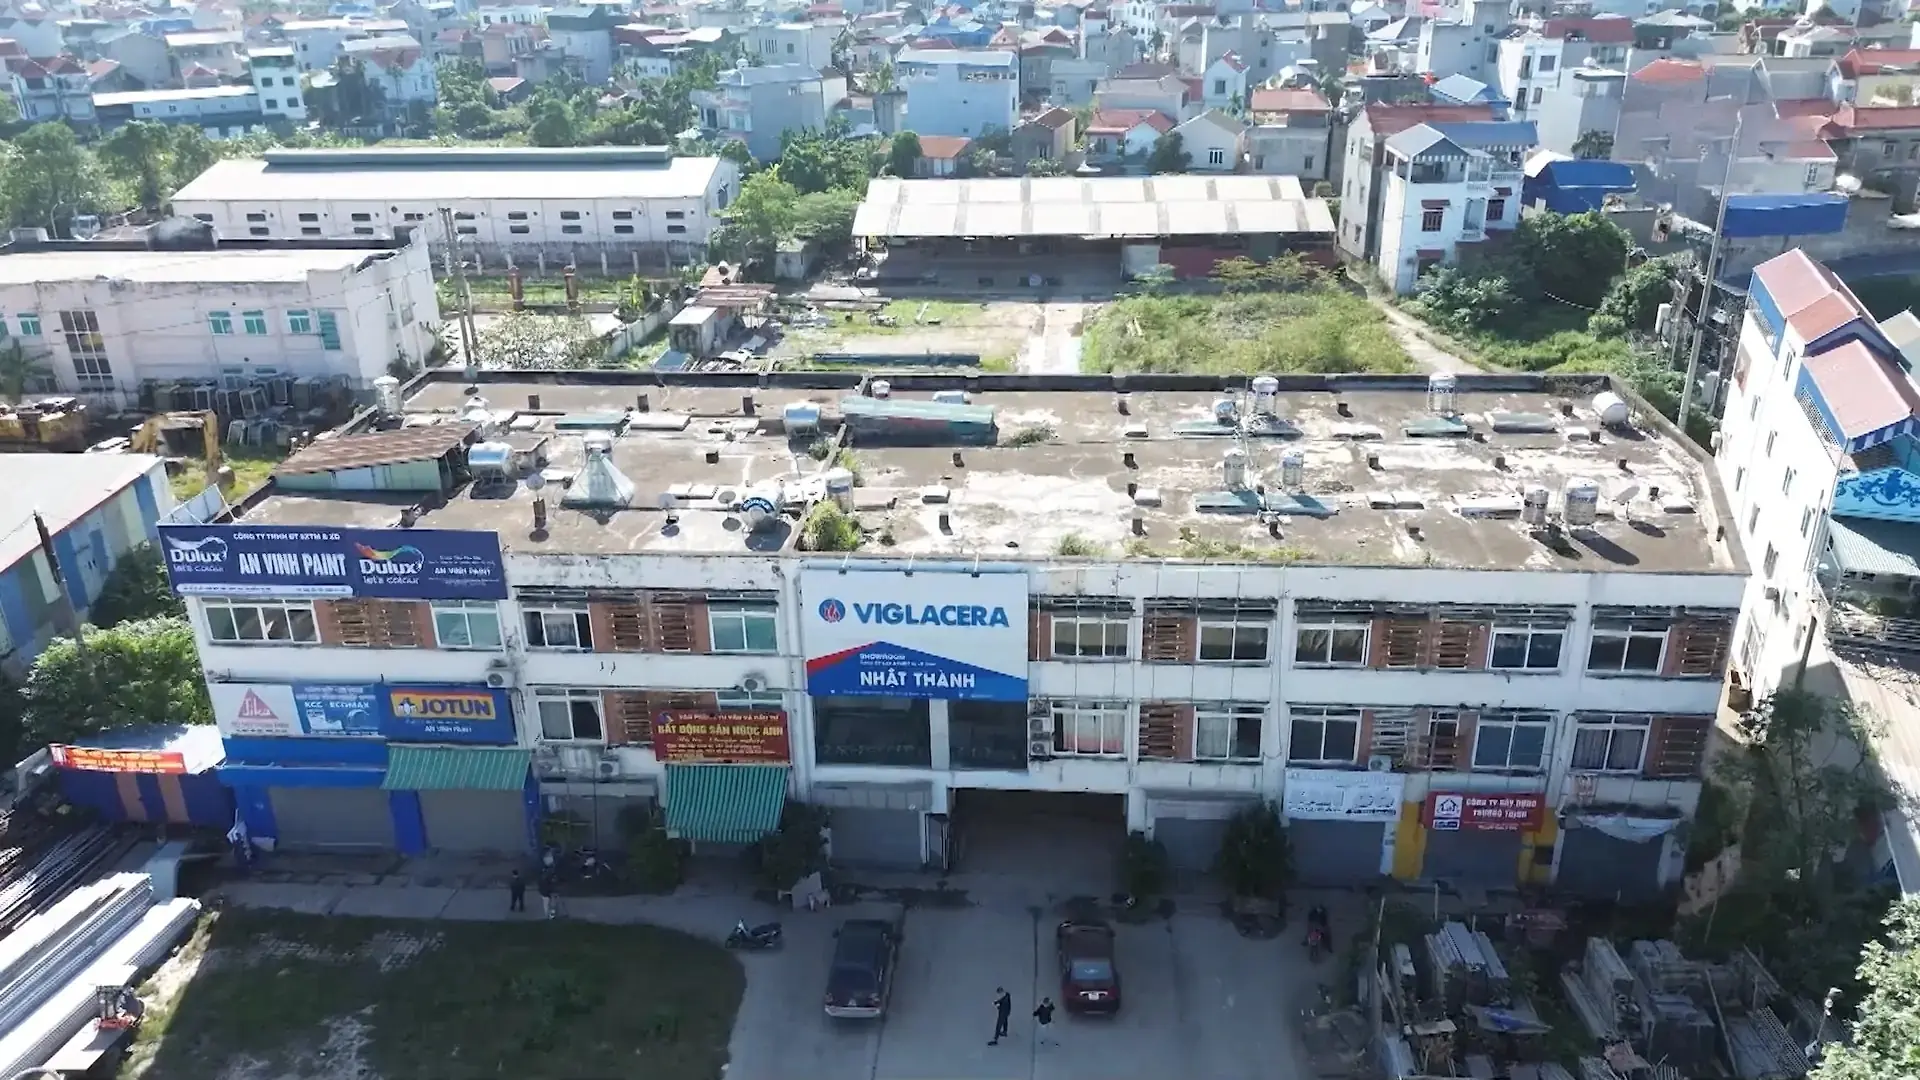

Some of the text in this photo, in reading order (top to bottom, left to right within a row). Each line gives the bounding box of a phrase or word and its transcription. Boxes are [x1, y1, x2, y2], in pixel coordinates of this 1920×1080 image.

[232, 531, 255, 541] CÔNG
[169, 548, 222, 563] Dulux
[239, 552, 347, 577] AN VINH PAINT
[360, 558, 417, 575] Dulux
[853, 603, 1010, 628] VIGLACERA
[860, 667, 976, 689] NHẬT THÀNH
[243, 697, 271, 717] Sika
[304, 701, 324, 709] KCC
[418, 698, 492, 716] JOTUN
